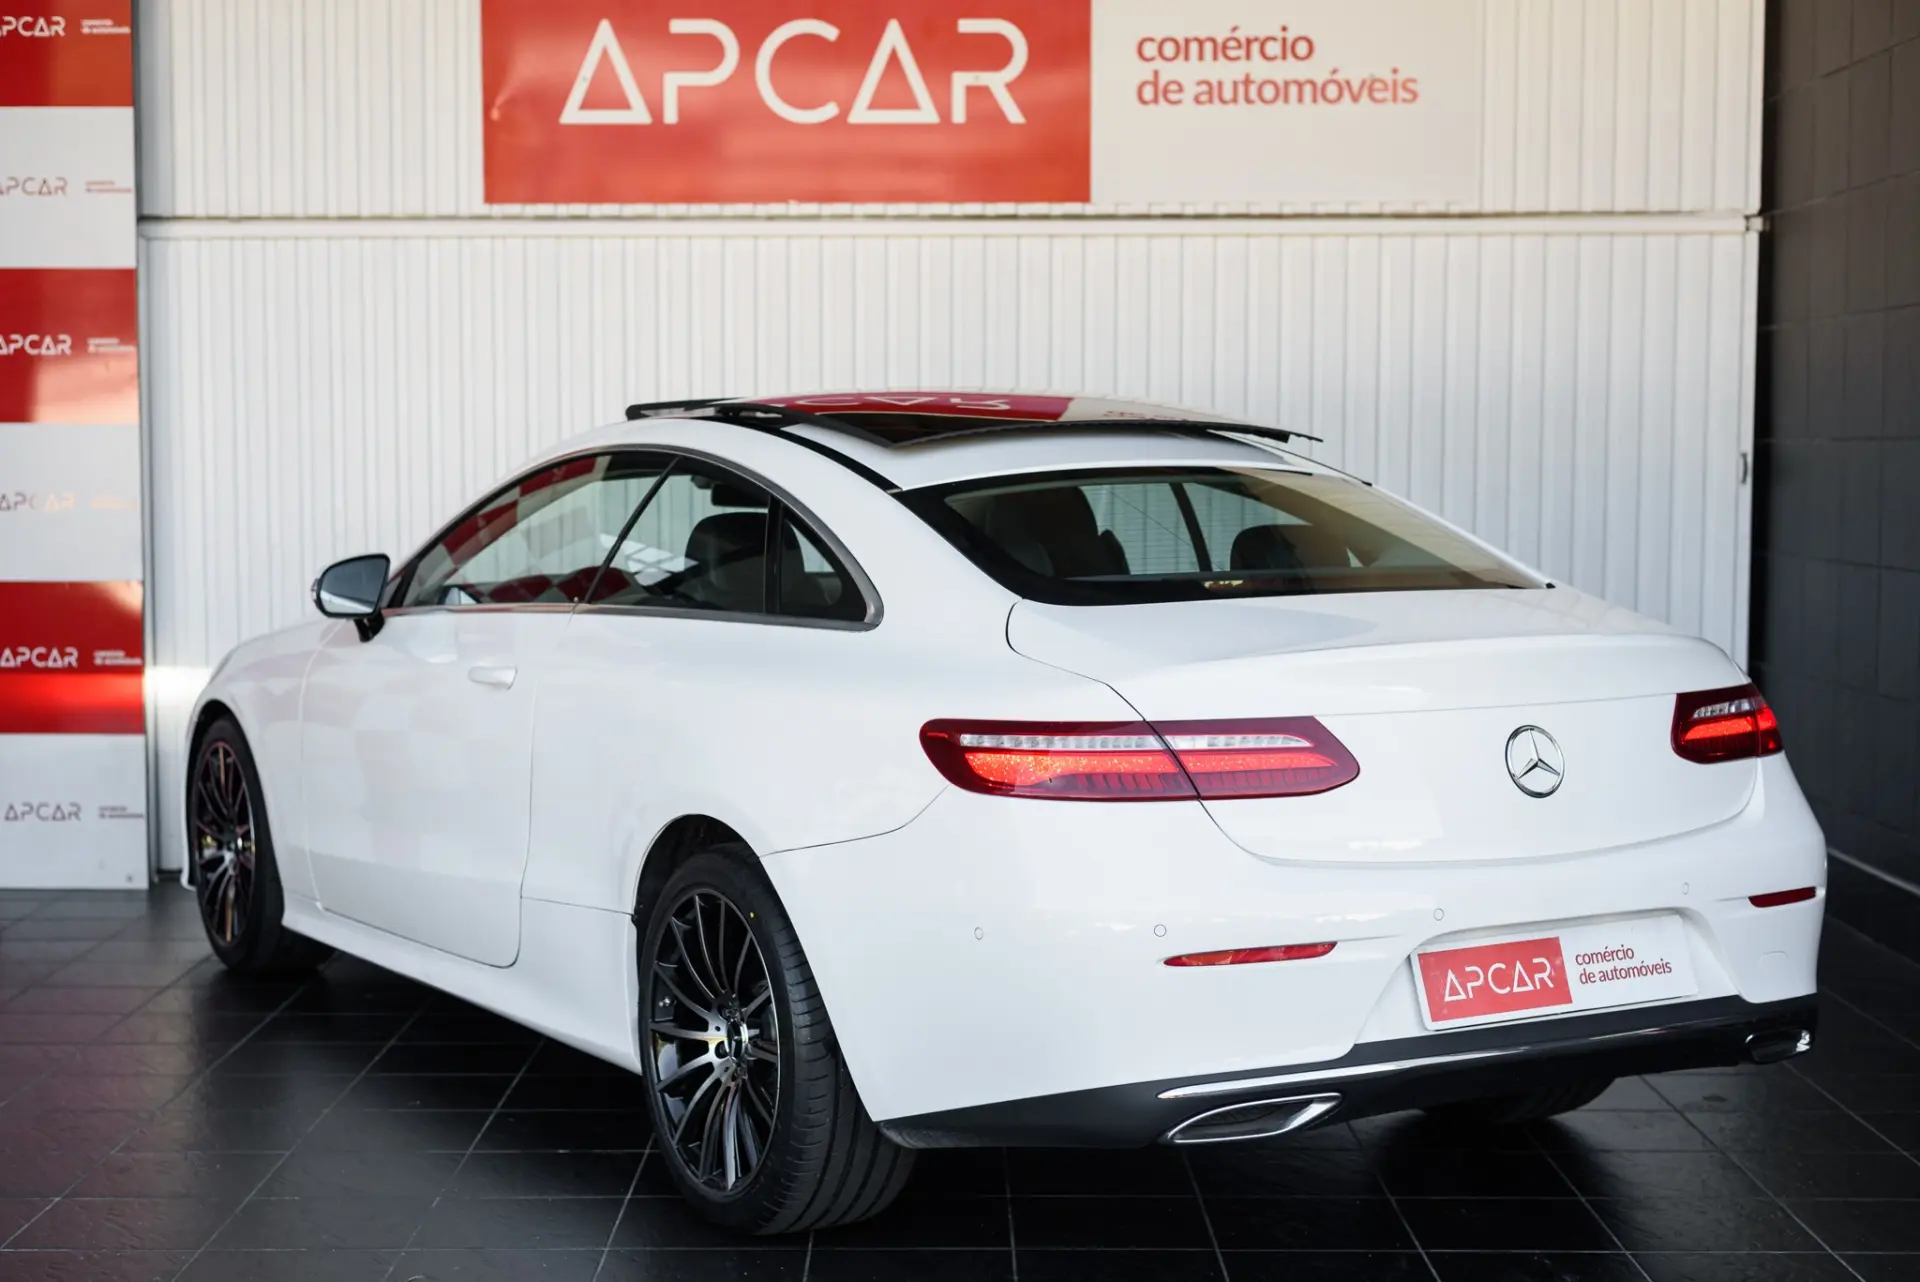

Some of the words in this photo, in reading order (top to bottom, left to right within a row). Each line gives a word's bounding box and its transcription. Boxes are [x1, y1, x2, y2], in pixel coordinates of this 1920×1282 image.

[0, 15, 67, 37] PCAR
[1136, 24, 1316, 63] comércio
[559, 18, 1029, 126] APCAR
[1136, 69, 1185, 106] de
[1193, 67, 1420, 106] automóveis
[0, 176, 68, 197] PCAR
[0, 646, 79, 669] APCAR
[4, 802, 82, 822] APCAR
[1575, 943, 1635, 967] comércio
[1444, 957, 1555, 1003] APCAR
[1579, 968, 1597, 986] de
[1598, 957, 1673, 983] automóveis
